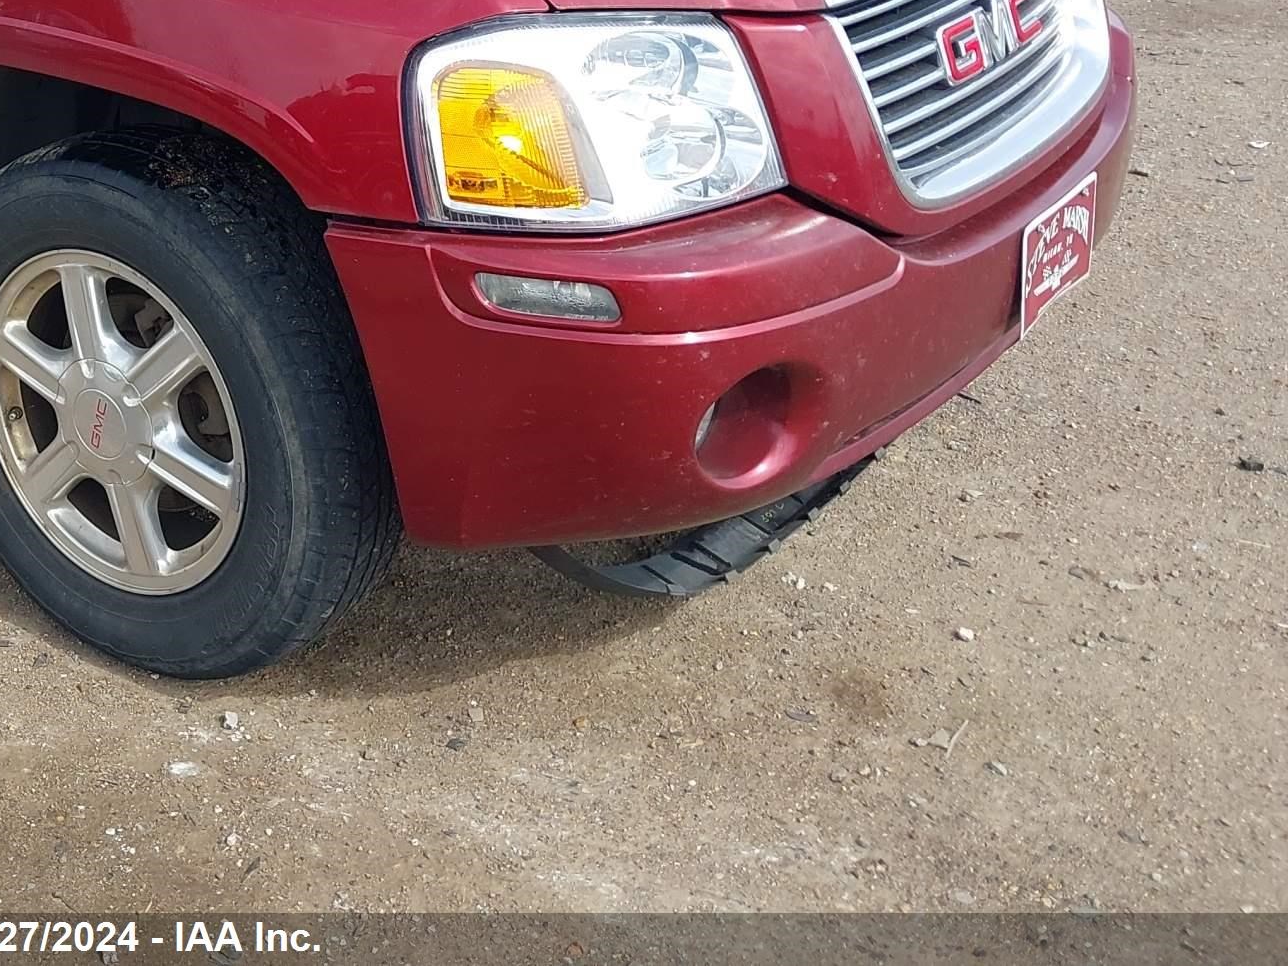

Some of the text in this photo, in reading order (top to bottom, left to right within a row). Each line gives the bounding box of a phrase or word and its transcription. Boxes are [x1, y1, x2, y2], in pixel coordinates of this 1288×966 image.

[1025, 212, 1061, 299] STEVE
[1062, 205, 1090, 246] MARSH
[91, 398, 108, 449] GMC
